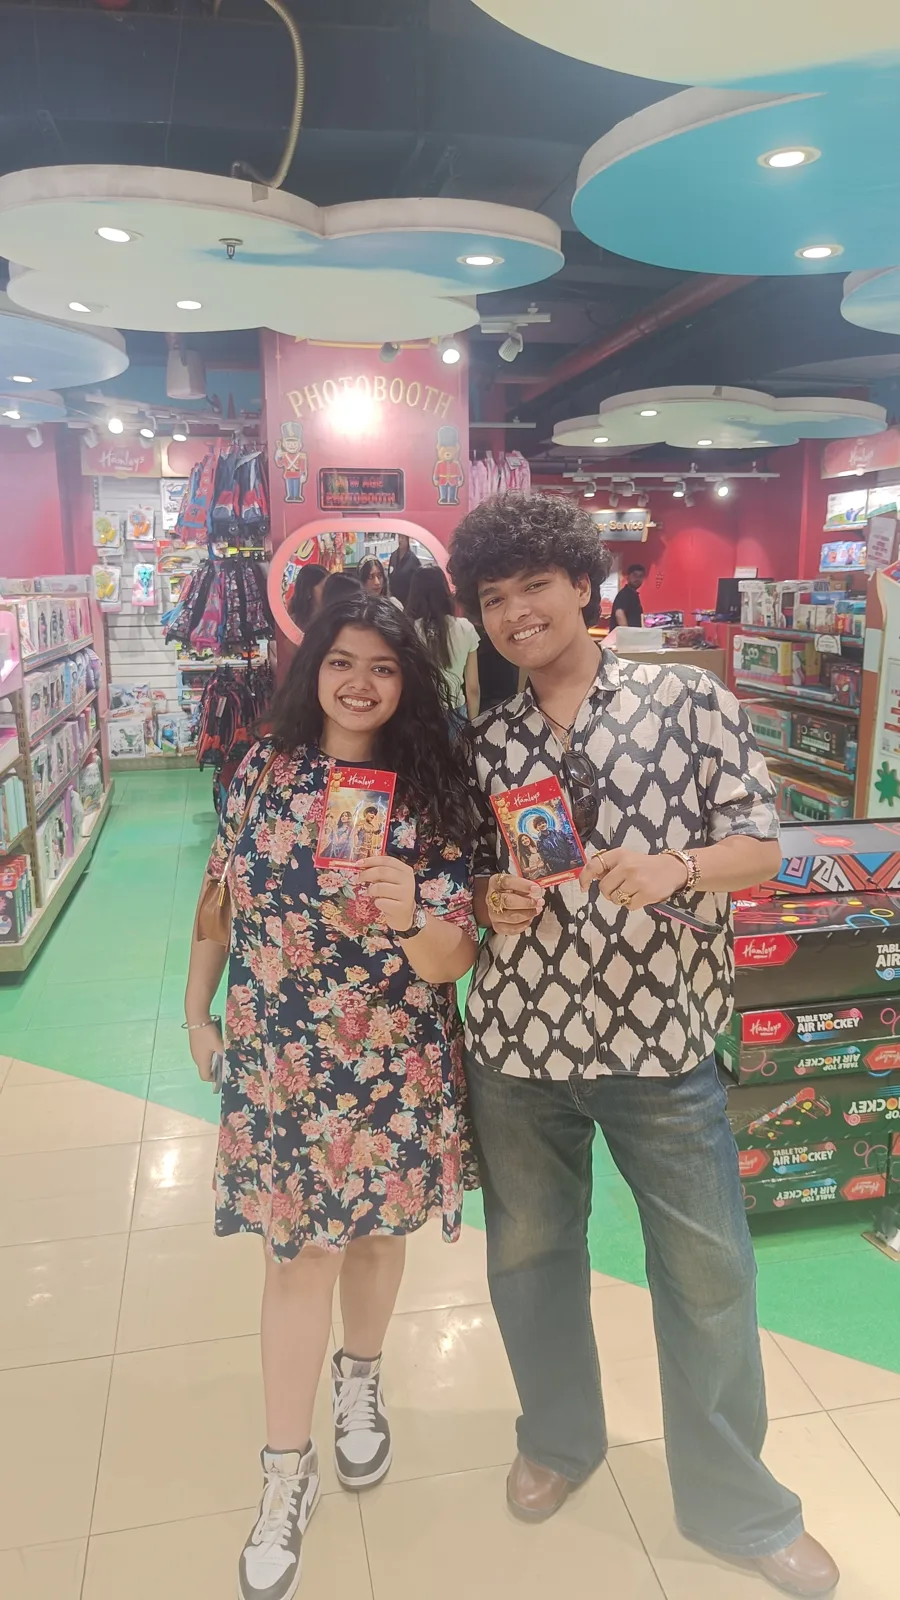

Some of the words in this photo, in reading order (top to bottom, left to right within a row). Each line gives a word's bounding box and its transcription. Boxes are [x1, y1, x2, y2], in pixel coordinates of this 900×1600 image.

[286, 375, 455, 419] PHOTOBOOTH
[99, 446, 145, 472] Hamleys
[609, 520, 644, 531] Service
[347, 773, 375, 789] Hamleys
[513, 791, 540, 807] Hamleys
[742, 938, 777, 958] Hamleys
[876, 943, 900, 954] TABL
[796, 1014, 818, 1023] TABLE
[818, 1012, 834, 1022] TOP
[750, 1019, 782, 1036] Hamleys
[797, 1022, 815, 1034] AIR
[817, 1017, 860, 1032] HOCKEY
[798, 1054, 839, 1067] HOCKEY
[839, 1053, 861, 1063] AIR
[823, 1063, 837, 1071] TOP
[837, 1061, 859, 1070] TABLE
[848, 1098, 900, 1115] OCKEY
[885, 1109, 900, 1120] OP
[773, 1148, 793, 1157] TABLE
[793, 1146, 808, 1155] TOP
[773, 1155, 790, 1166] AIR
[792, 1150, 834, 1163] HOCKEY
[776, 1187, 818, 1200] HOCKEY
[819, 1185, 837, 1194] AIR
[801, 1195, 815, 1203] TOP
[815, 1192, 836, 1201] TABLE
